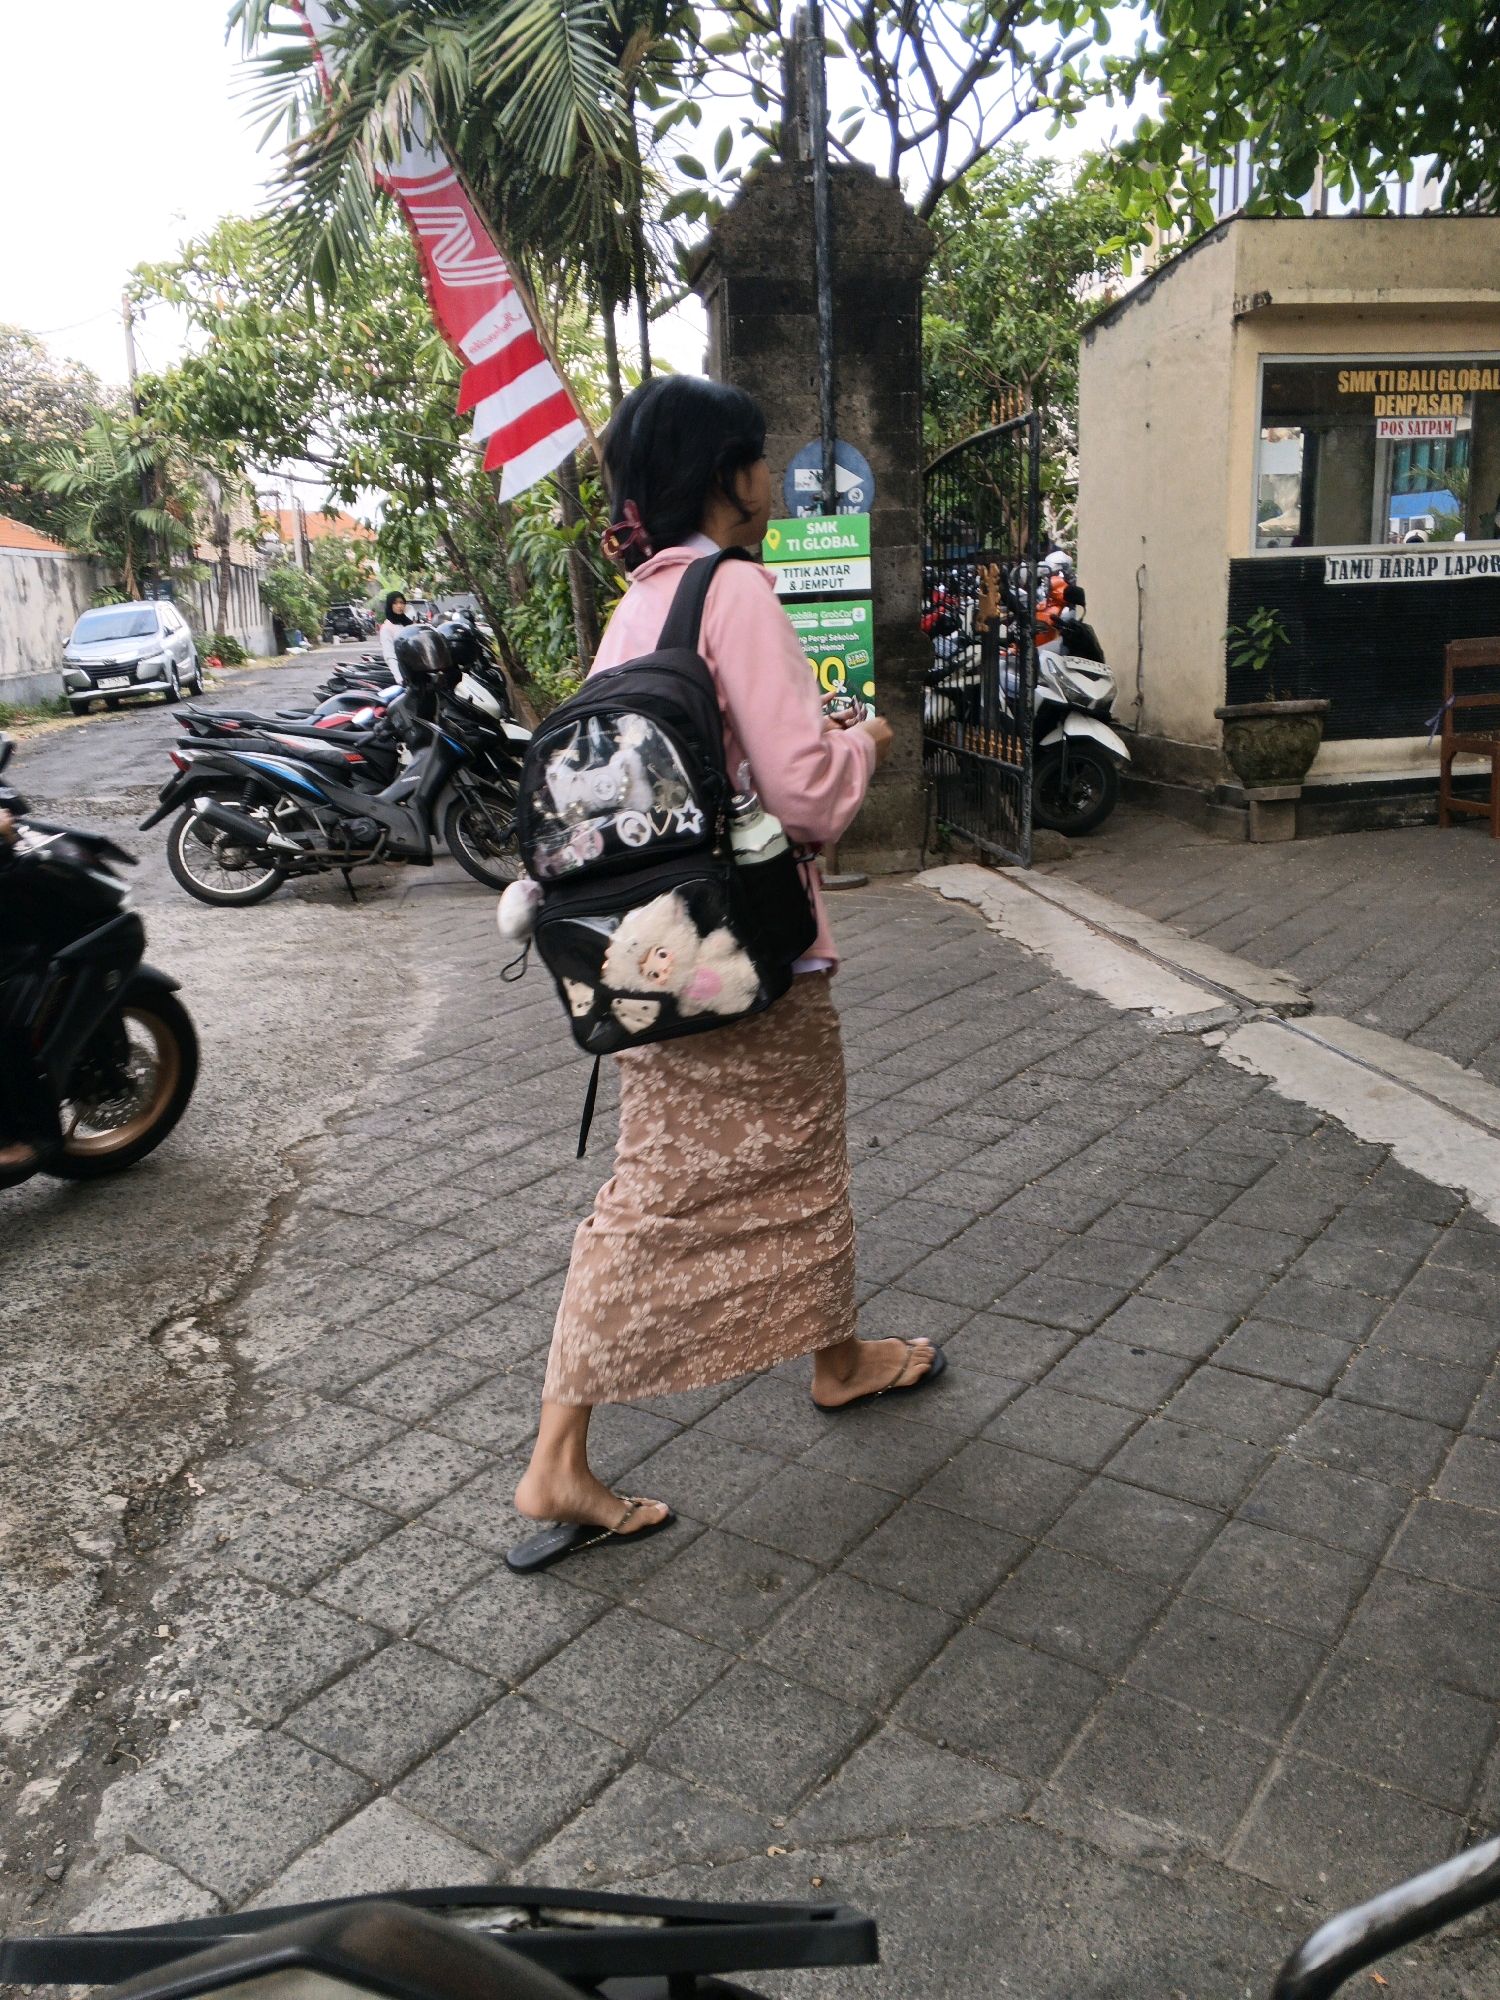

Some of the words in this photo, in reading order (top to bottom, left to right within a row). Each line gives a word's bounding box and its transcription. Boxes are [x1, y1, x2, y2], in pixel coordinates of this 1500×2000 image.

[1337, 370, 1378, 393] SMK
[1397, 369, 1436, 392] BALI
[1437, 368, 1500, 392] GLOBAL
[1374, 393, 1464, 416] DENPASAR
[1380, 420, 1404, 436] POS
[1408, 419, 1453, 435] SATPAM
[806, 520, 838, 535] SMK
[786, 538, 801, 551] TI
[802, 534, 859, 551] GLOBAL
[783, 566, 811, 579] TITIK
[813, 564, 851, 577] ANTAR
[1329, 558, 1374, 580] TAMU
[1379, 556, 1439, 579] HARAP
[1444, 554, 1500, 576] LAPOR
[789, 581, 796, 591] &
[799, 578, 844, 591] JEMPUT
[808, 633, 828, 644] Pergi
[828, 632, 860, 642] Sekolah
